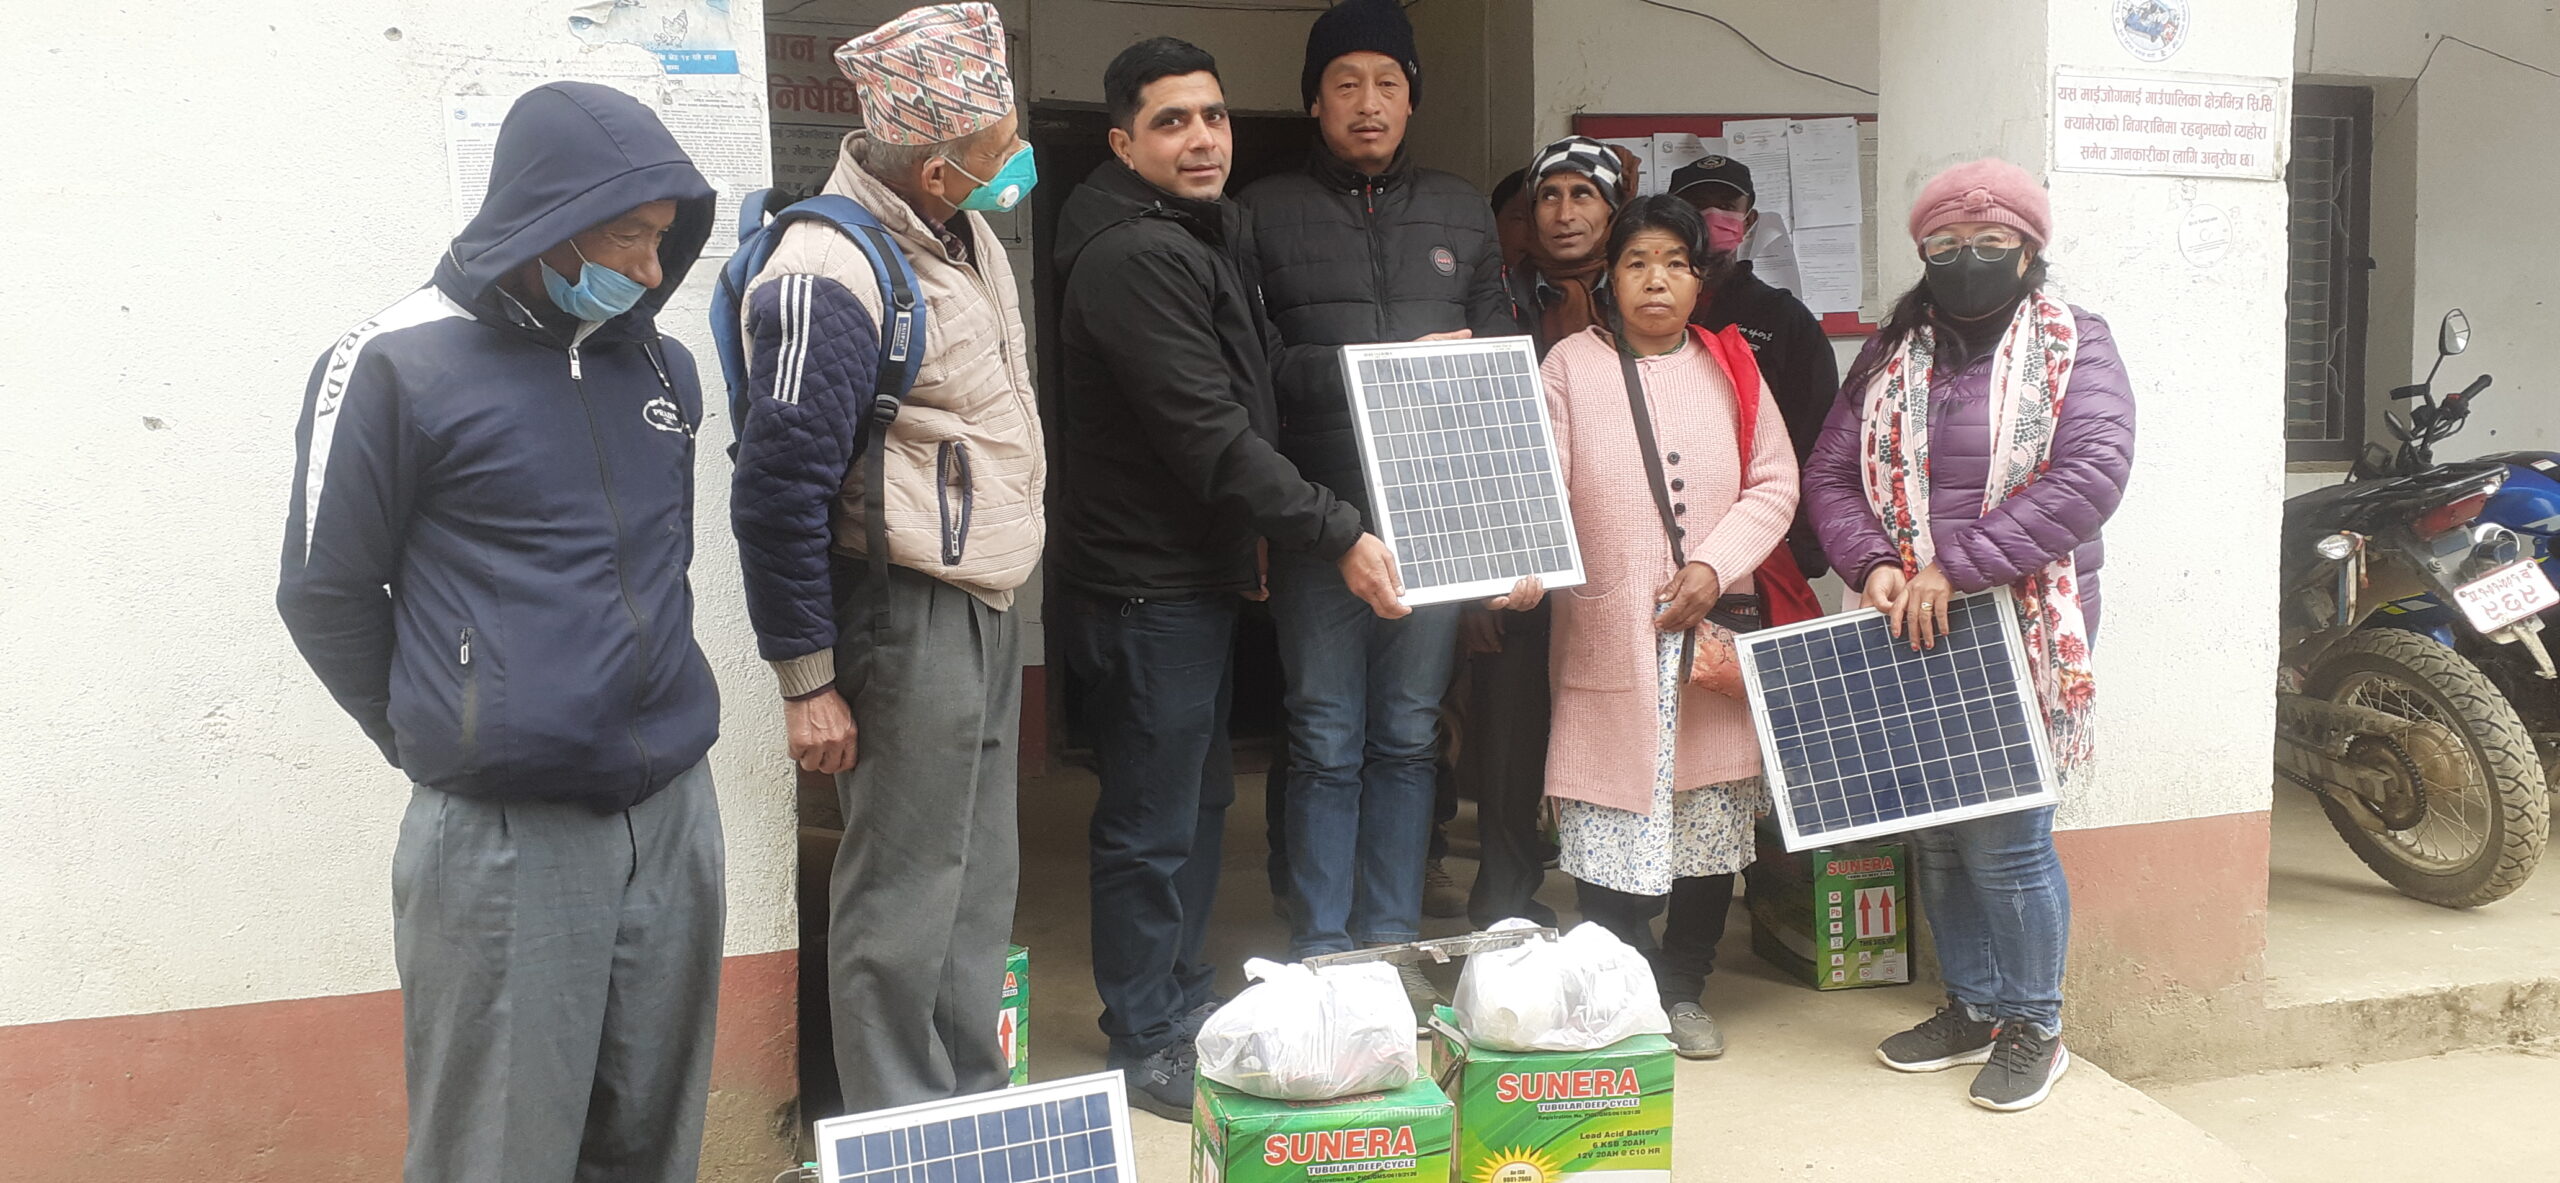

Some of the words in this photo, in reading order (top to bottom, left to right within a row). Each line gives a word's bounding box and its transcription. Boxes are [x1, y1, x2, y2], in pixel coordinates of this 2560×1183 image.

[2058, 86, 2077, 102] यस
[2080, 85, 2142, 106] माईजोगमाई
[2064, 113, 2120, 132] क्यामेराको
[2122, 115, 2177, 134] निगरानिमा
[2181, 120, 2232, 140] रहनुभएको
[2234, 122, 2267, 140] व्यहोरा
[2080, 142, 2107, 161] समेत
[2110, 145, 2170, 163] जानकारीका
[2173, 146, 2198, 164] लागि
[317, 320, 381, 418] PRADA
[1826, 856, 1894, 876] SUNERA
[1497, 1067, 1640, 1103] SUNERA
[1539, 1102, 1582, 1112] TUBULAR
[1584, 1101, 1608, 1109] DEEP
[1610, 1098, 1639, 1108] CYCLE
[1580, 1132, 1602, 1140] Lead
[1604, 1130, 1625, 1138] Acid
[1627, 1128, 1659, 1136] Battery
[1622, 1139, 1646, 1147] 20AH
[1264, 1125, 1417, 1165] SUNERA
[1308, 1164, 1355, 1175] TUBULAR
[1357, 1162, 1382, 1171] DEEP
[1384, 1159, 1415, 1169] CYCLE
